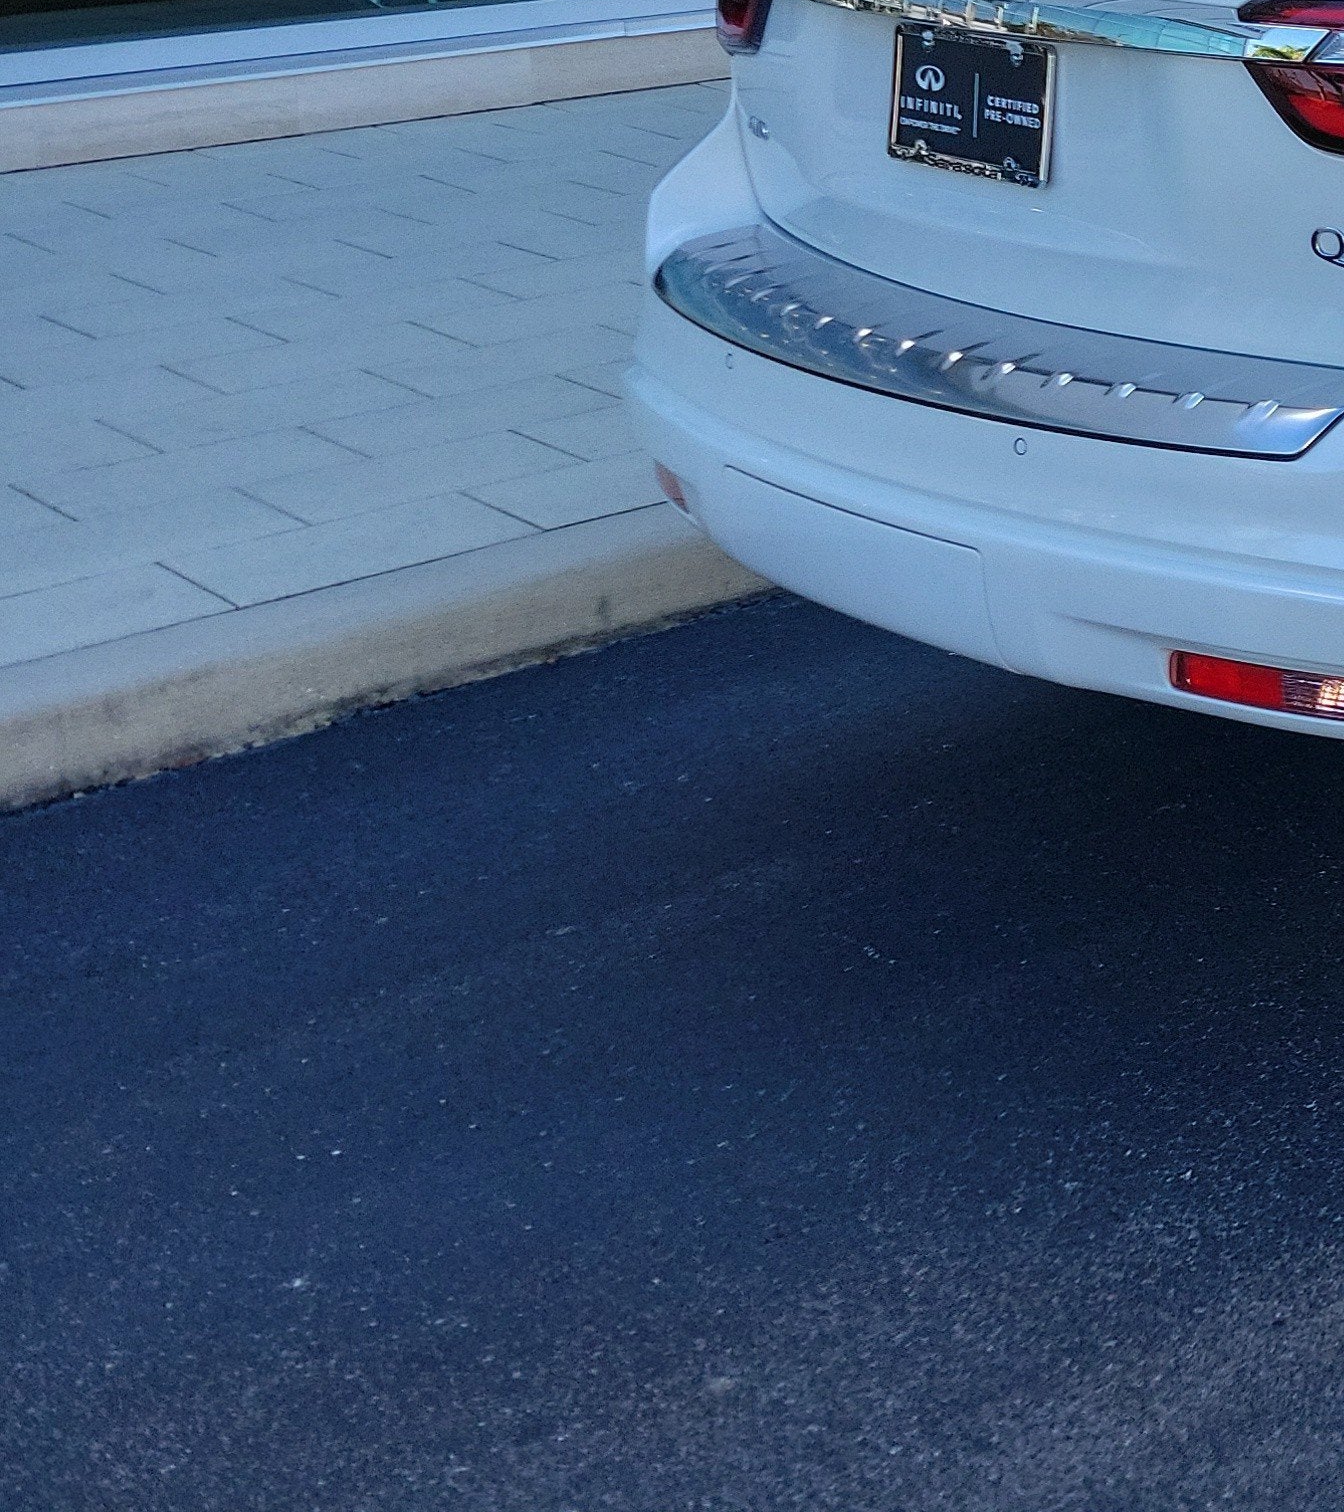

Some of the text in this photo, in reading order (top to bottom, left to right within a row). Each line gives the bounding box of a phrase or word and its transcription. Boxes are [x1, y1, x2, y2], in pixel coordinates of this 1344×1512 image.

[900, 95, 961, 119] INFINITI
[986, 94, 1040, 115] CERTIFIED
[983, 108, 1041, 130] PRE-OWNED
